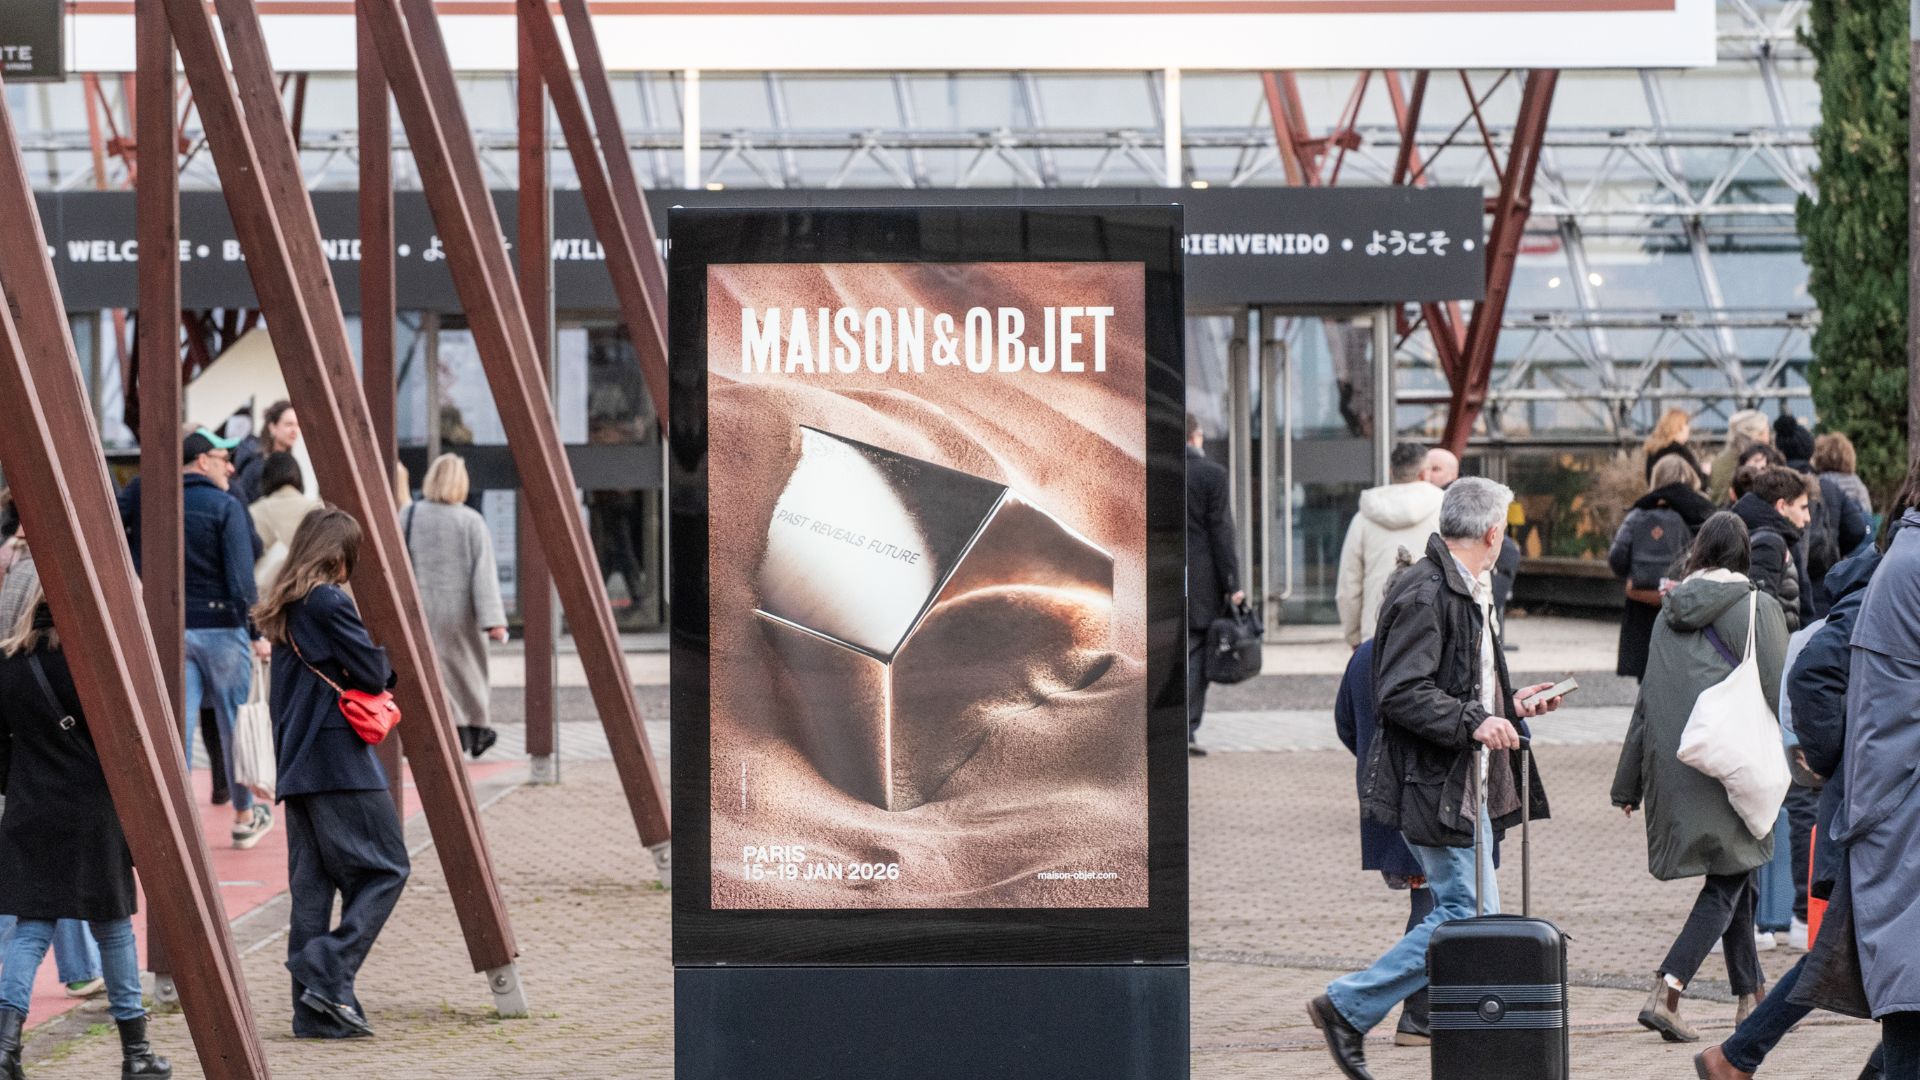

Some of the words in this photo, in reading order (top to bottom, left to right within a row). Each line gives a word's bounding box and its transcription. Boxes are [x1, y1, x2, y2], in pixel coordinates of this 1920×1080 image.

[67, 240, 190, 261] WELCE
[1365, 229, 1451, 256] ようこそ
[776, 509, 810, 528] PAST
[810, 520, 866, 547] REVEALS
[867, 539, 921, 565] FUTURE
[743, 845, 807, 863] PARIS
[803, 863, 843, 880] JAN
[848, 863, 900, 880] 2026
[1037, 870, 1118, 880] maison-objet.com
